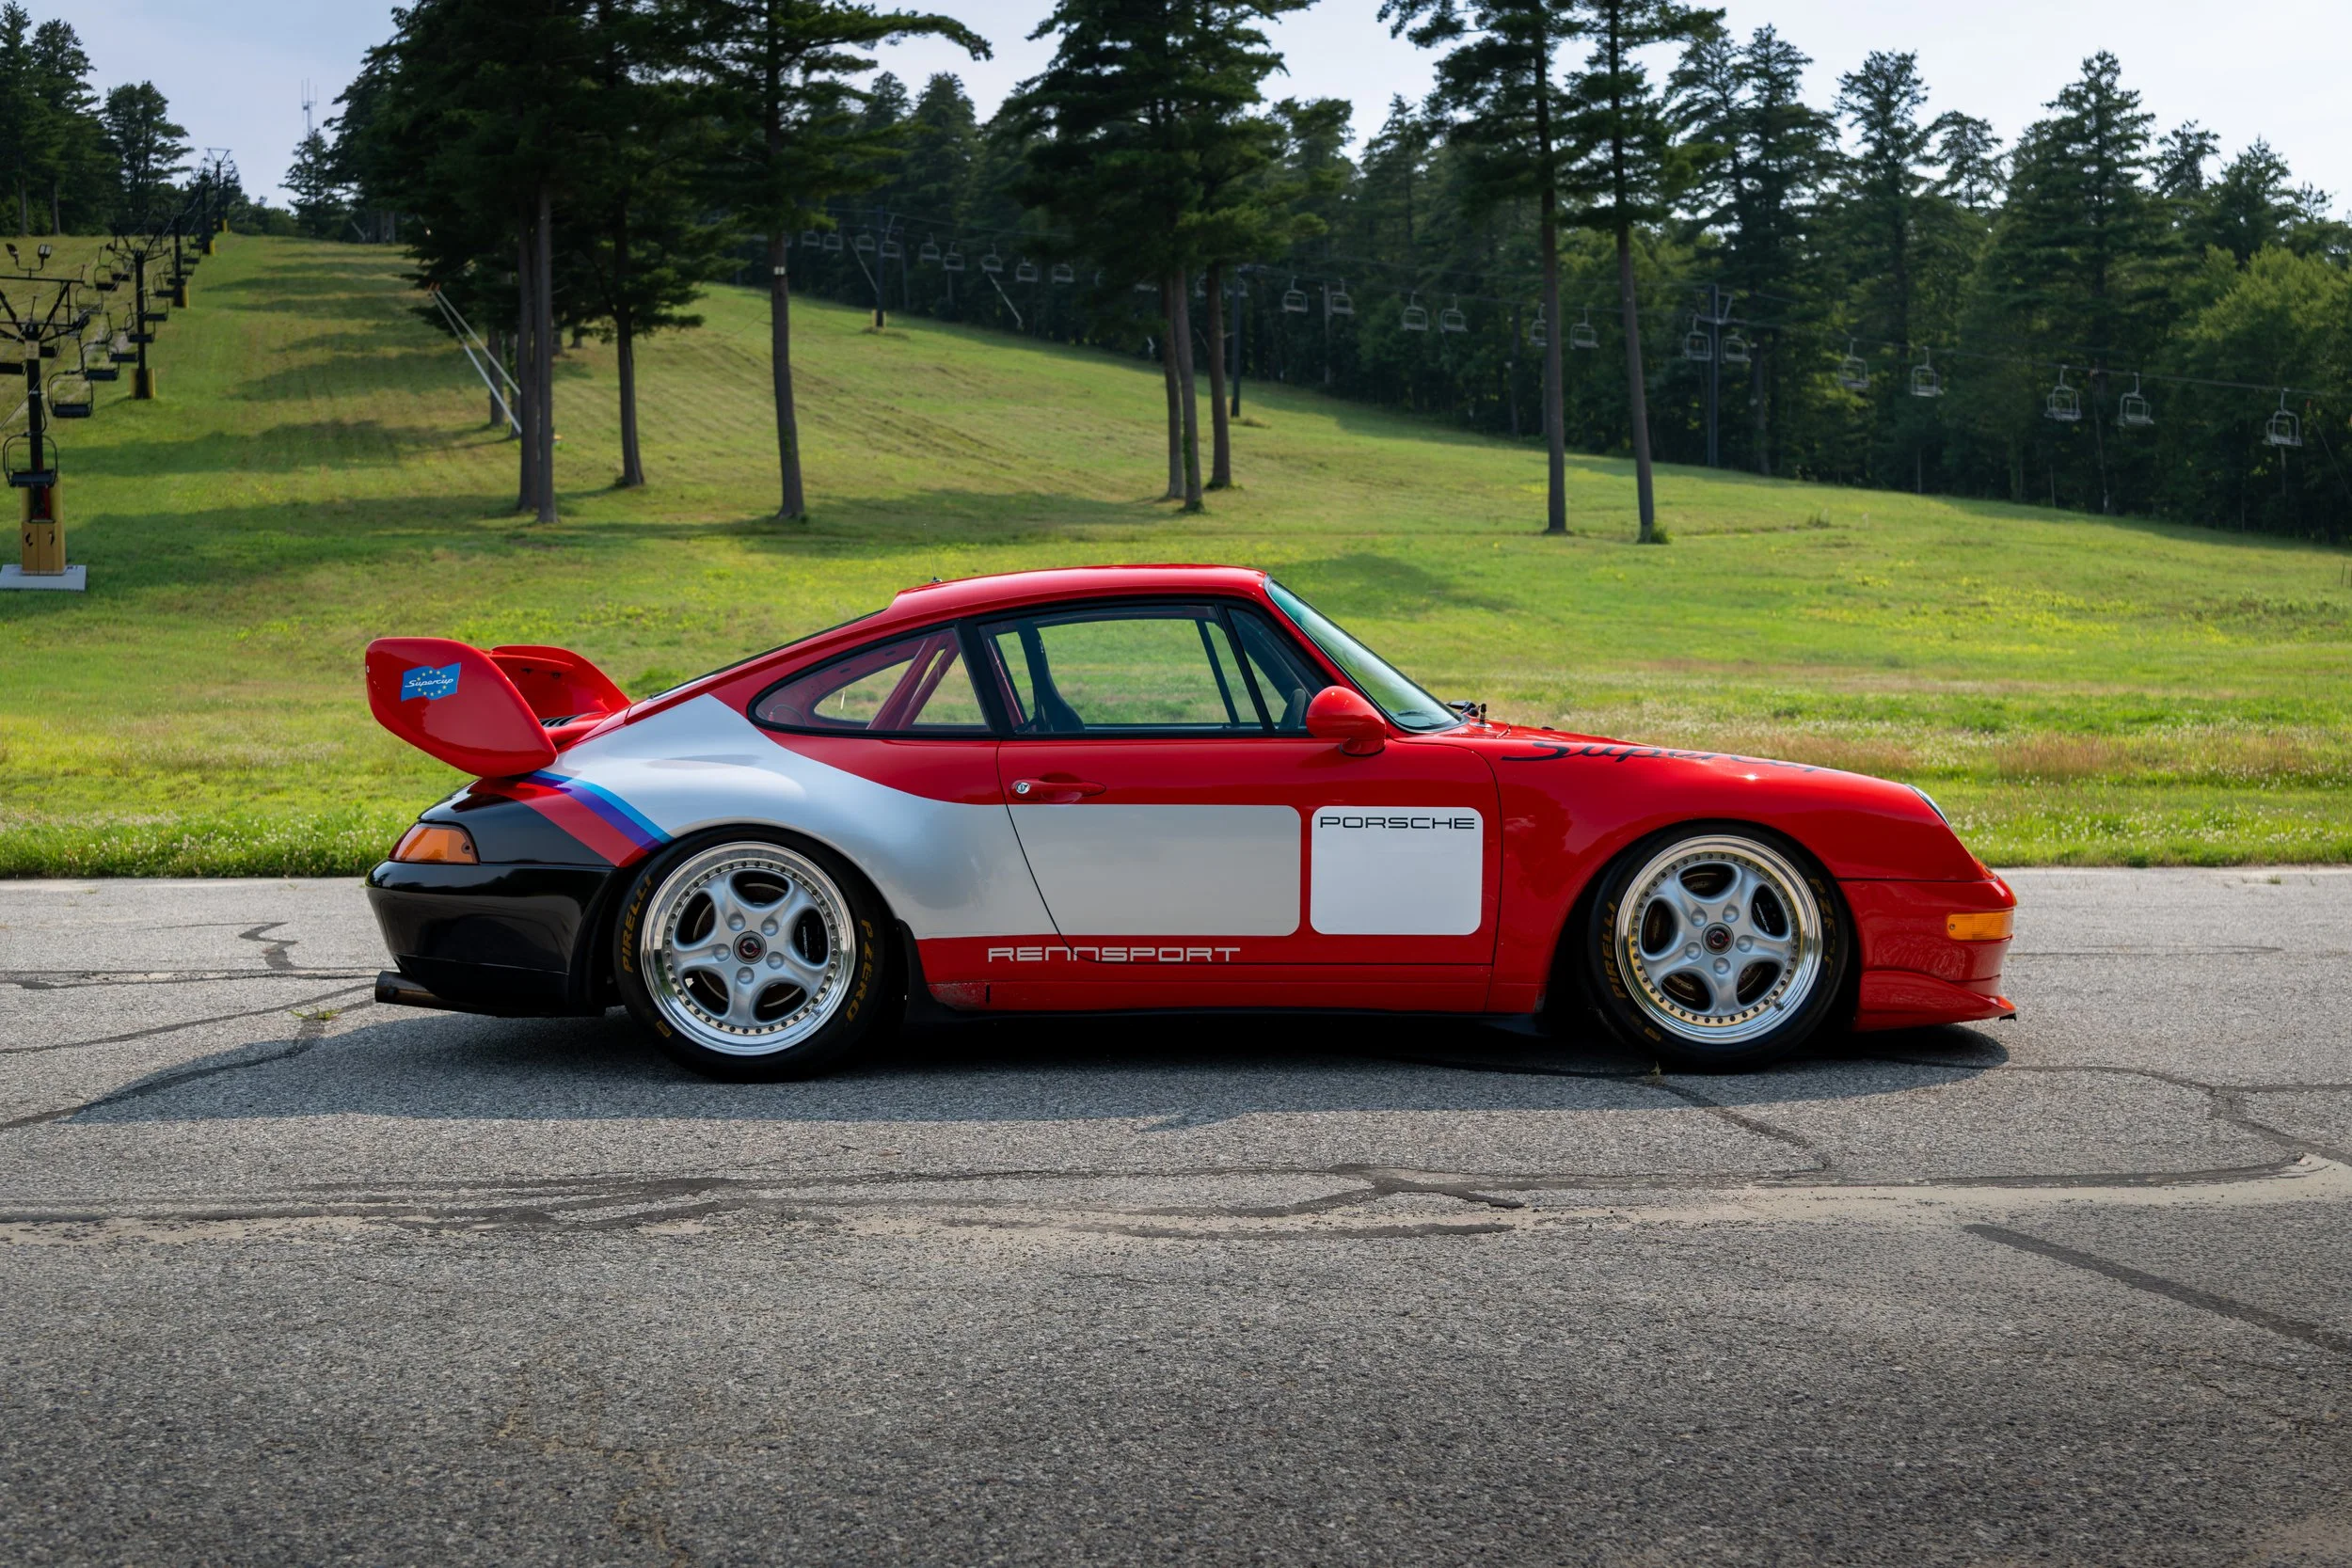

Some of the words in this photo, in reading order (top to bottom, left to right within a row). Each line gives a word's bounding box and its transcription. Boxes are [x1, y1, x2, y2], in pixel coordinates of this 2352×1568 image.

[405, 678, 453, 688] Supercup
[1320, 816, 1475, 830] PORSCHE
[622, 875, 652, 974] PIRELLI
[987, 946, 1241, 963] RENNSPORT
[1602, 901, 1629, 1000] PIRELLI
